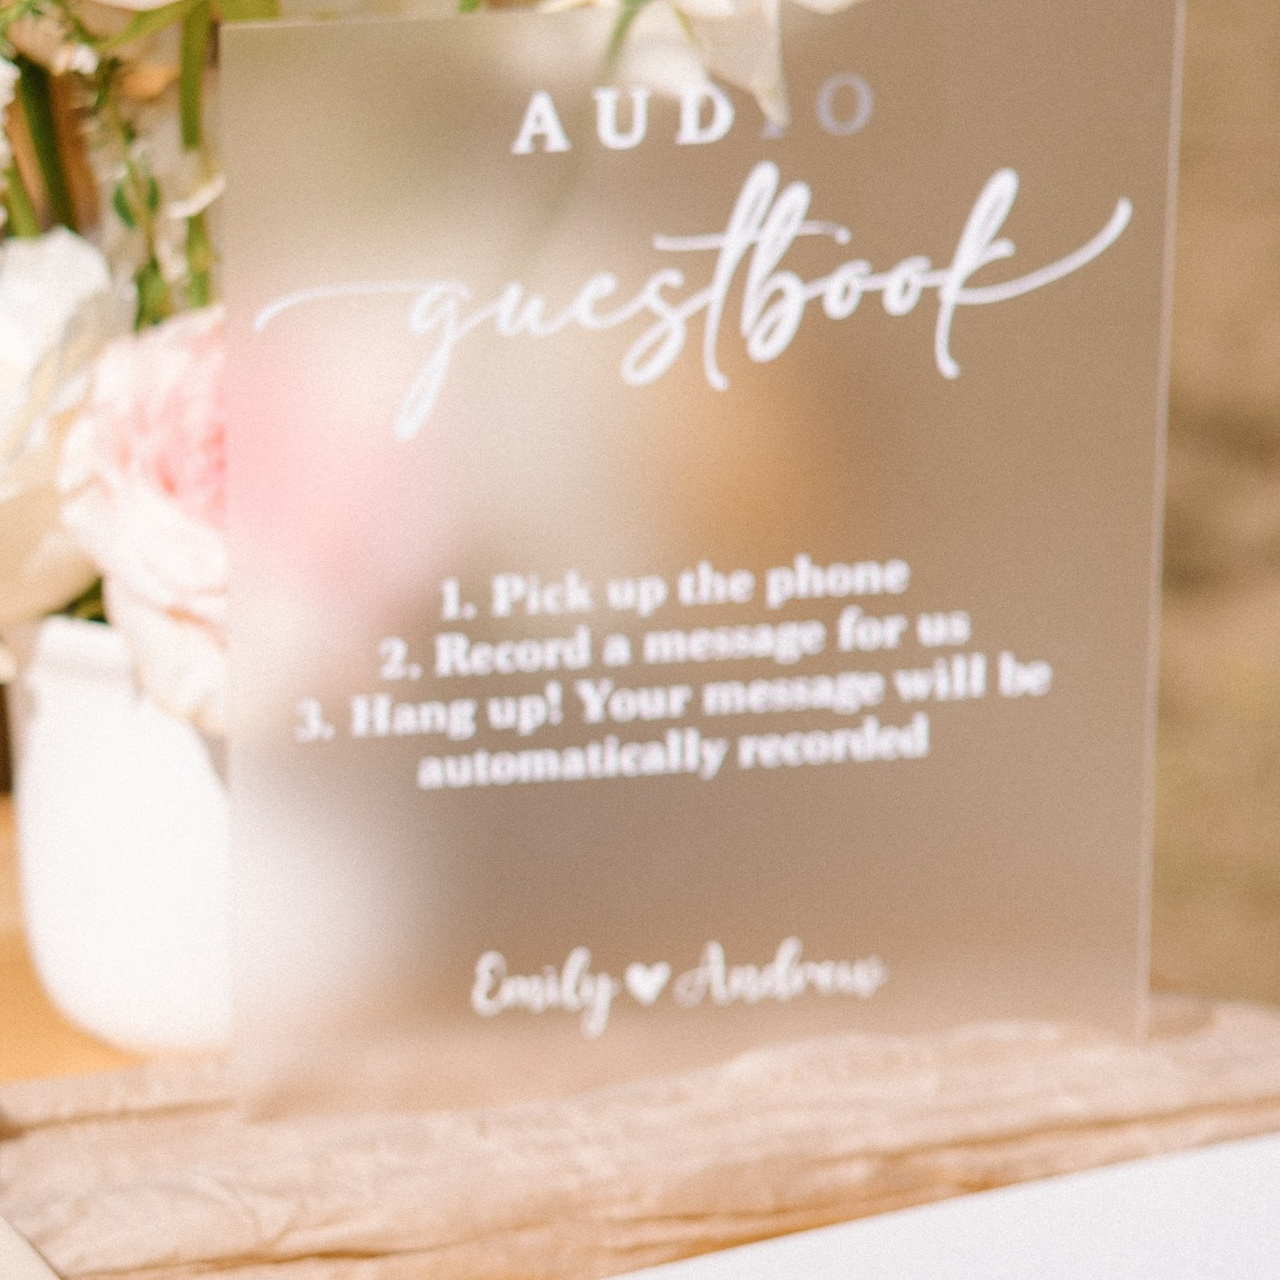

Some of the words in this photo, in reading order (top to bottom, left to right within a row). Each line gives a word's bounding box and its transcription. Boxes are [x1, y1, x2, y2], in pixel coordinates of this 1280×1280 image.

[510, 72, 875, 155] AUDO
[252, 160, 1133, 441] guestbook
[441, 579, 477, 620] 1.
[492, 569, 593, 617] Pick
[609, 569, 666, 616] up
[678, 561, 755, 607] the
[766, 554, 910, 609] phone
[378, 637, 421, 680] 2.
[434, 627, 590, 677] Record
[602, 635, 631, 666] a
[643, 614, 825, 663] message
[838, 605, 905, 650] for
[917, 612, 971, 644] us
[293, 699, 335, 741] 3.
[351, 694, 477, 740] Hang
[489, 682, 562, 734] up!
[576, 681, 691, 723] Your
[702, 666, 884, 715] message
[895, 654, 986, 701] will
[998, 651, 1052, 696] be
[416, 727, 727, 789] automatically
[738, 713, 929, 770] recorded
[470, 945, 619, 1037] Emily
[673, 936, 888, 1007] Andrew
